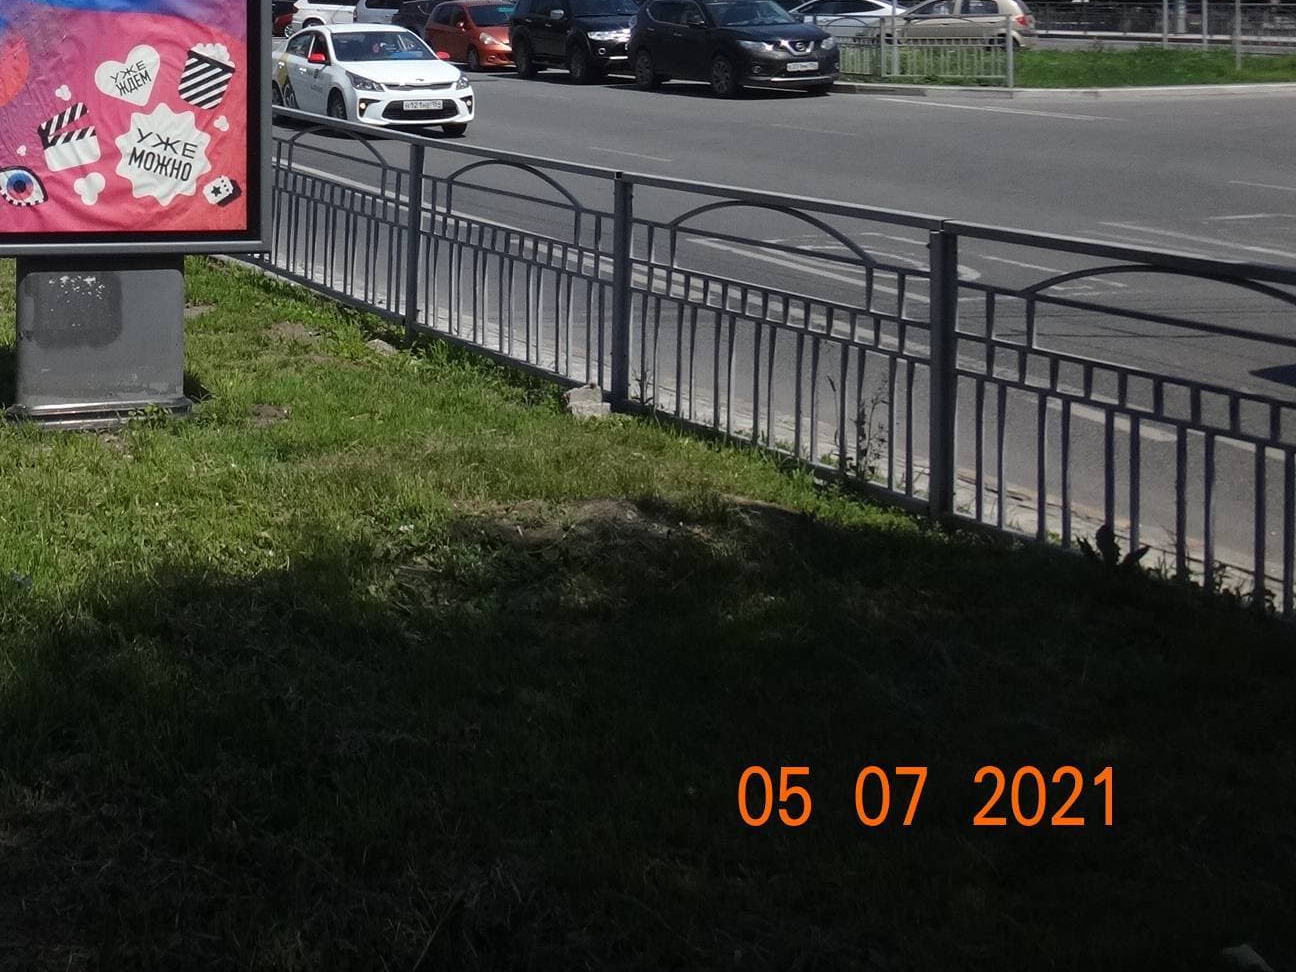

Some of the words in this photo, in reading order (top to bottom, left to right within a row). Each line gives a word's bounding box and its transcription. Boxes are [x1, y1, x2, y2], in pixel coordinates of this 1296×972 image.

[110, 60, 146, 83] УЖЕ
[115, 70, 152, 96] ЖДЕМ
[136, 127, 198, 160] УЖЕ
[128, 146, 193, 182] МОЖНО
